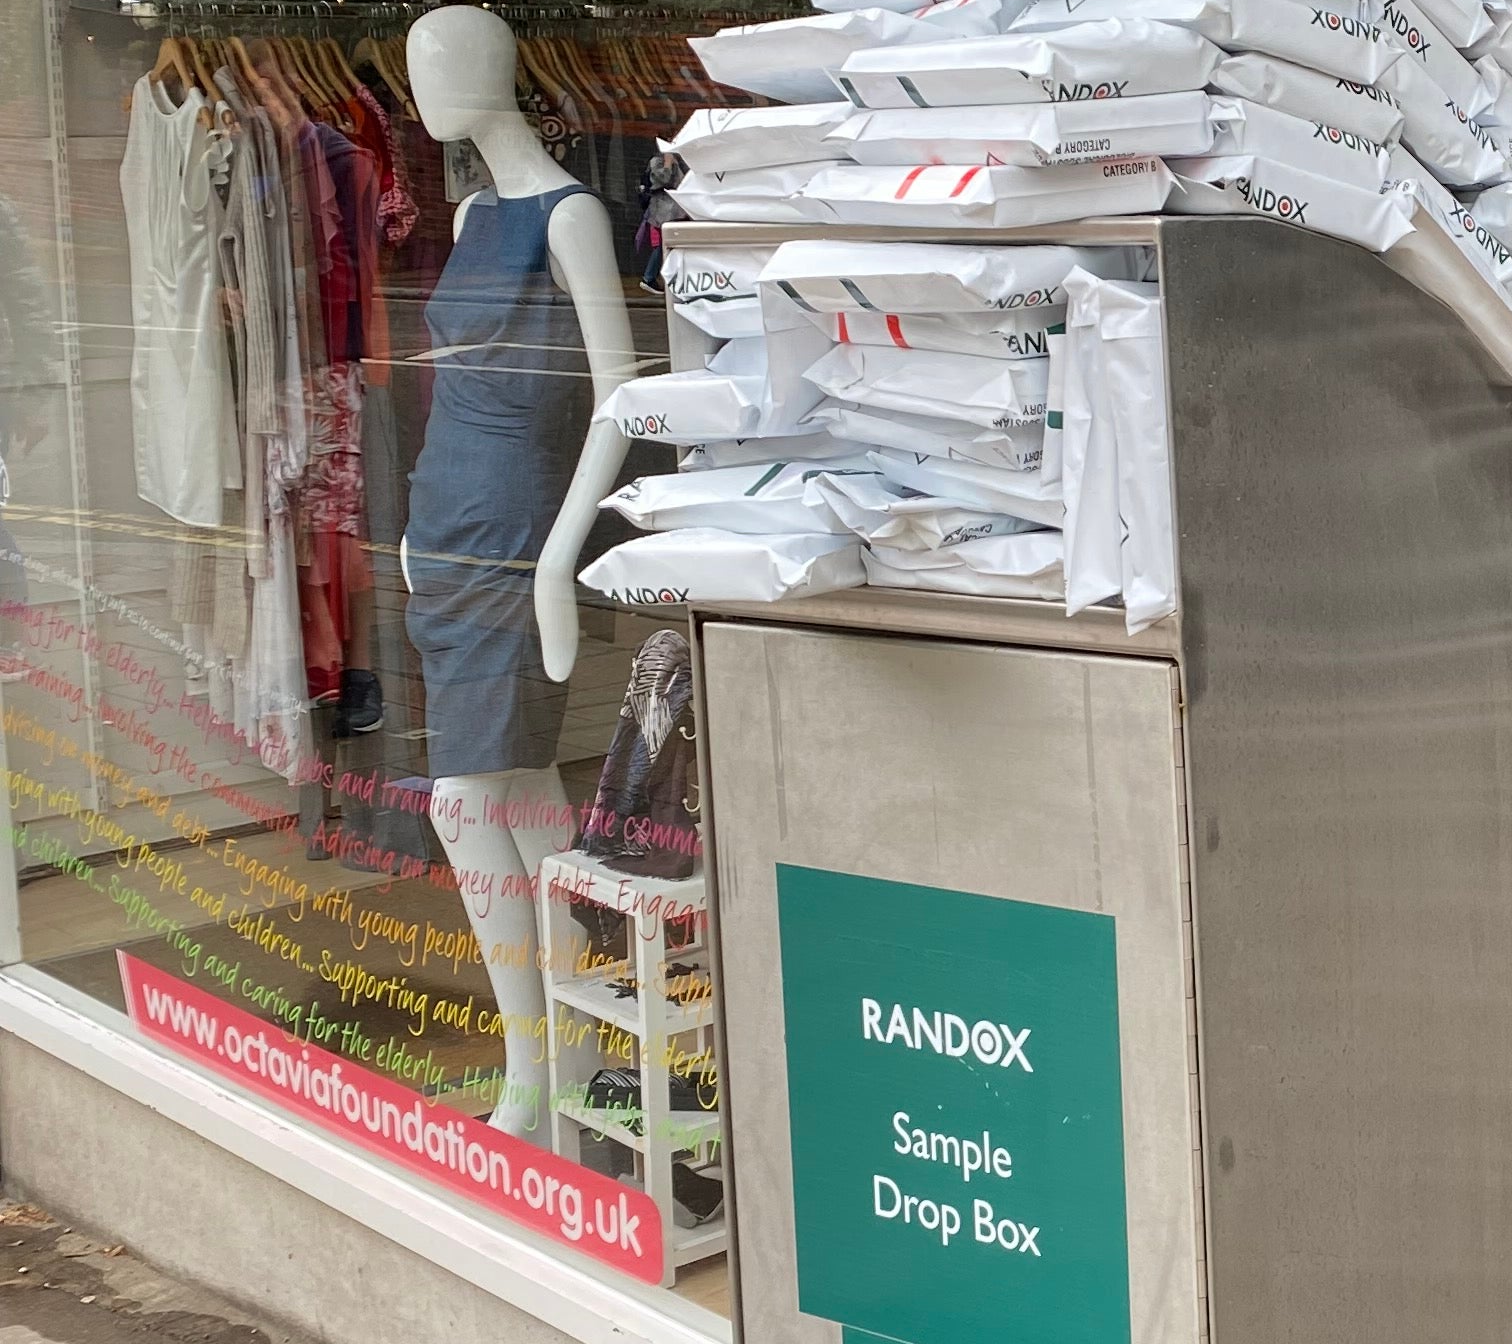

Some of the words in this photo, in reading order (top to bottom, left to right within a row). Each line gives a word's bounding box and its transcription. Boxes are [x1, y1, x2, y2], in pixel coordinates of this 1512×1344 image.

[1311, 7, 1381, 43] ANDOX
[1064, 138, 1111, 155] CATEGORY
[1103, 159, 1150, 179] CATEGORY
[1150, 157, 1157, 173] B
[1312, 121, 1383, 158] ANDOX
[1450, 198, 1512, 266] ANDOX
[984, 285, 1060, 311] NDOX
[615, 413, 673, 437] NDOX
[608, 587, 692, 605] ANDOX
[337, 769, 378, 804] and
[578, 799, 618, 838] the
[312, 819, 397, 895] Advising
[428, 859, 493, 919] money
[500, 862, 542, 904] and
[80, 808, 135, 870] young
[135, 839, 187, 896] people
[190, 884, 225, 925] and
[319, 949, 430, 1037] Supporting
[433, 996, 475, 1036] and
[545, 1005, 592, 1061] for
[595, 1016, 633, 1061] the
[223, 838, 309, 923] Engaging
[312, 885, 354, 928] with
[349, 910, 419, 968] young
[421, 920, 485, 976] people
[107, 873, 203, 977] Supporting
[203, 954, 241, 994] and
[241, 978, 303, 1043] caring
[299, 1000, 340, 1048] for
[340, 1020, 373, 1062] the
[463, 1064, 540, 1131] Helping
[862, 998, 1034, 1073] RANDOX
[142, 983, 642, 1258] www.octaviafoundation.org.uk
[893, 1111, 1013, 1182] Sample
[874, 1174, 961, 1246] Drop
[973, 1198, 1042, 1258] Box
